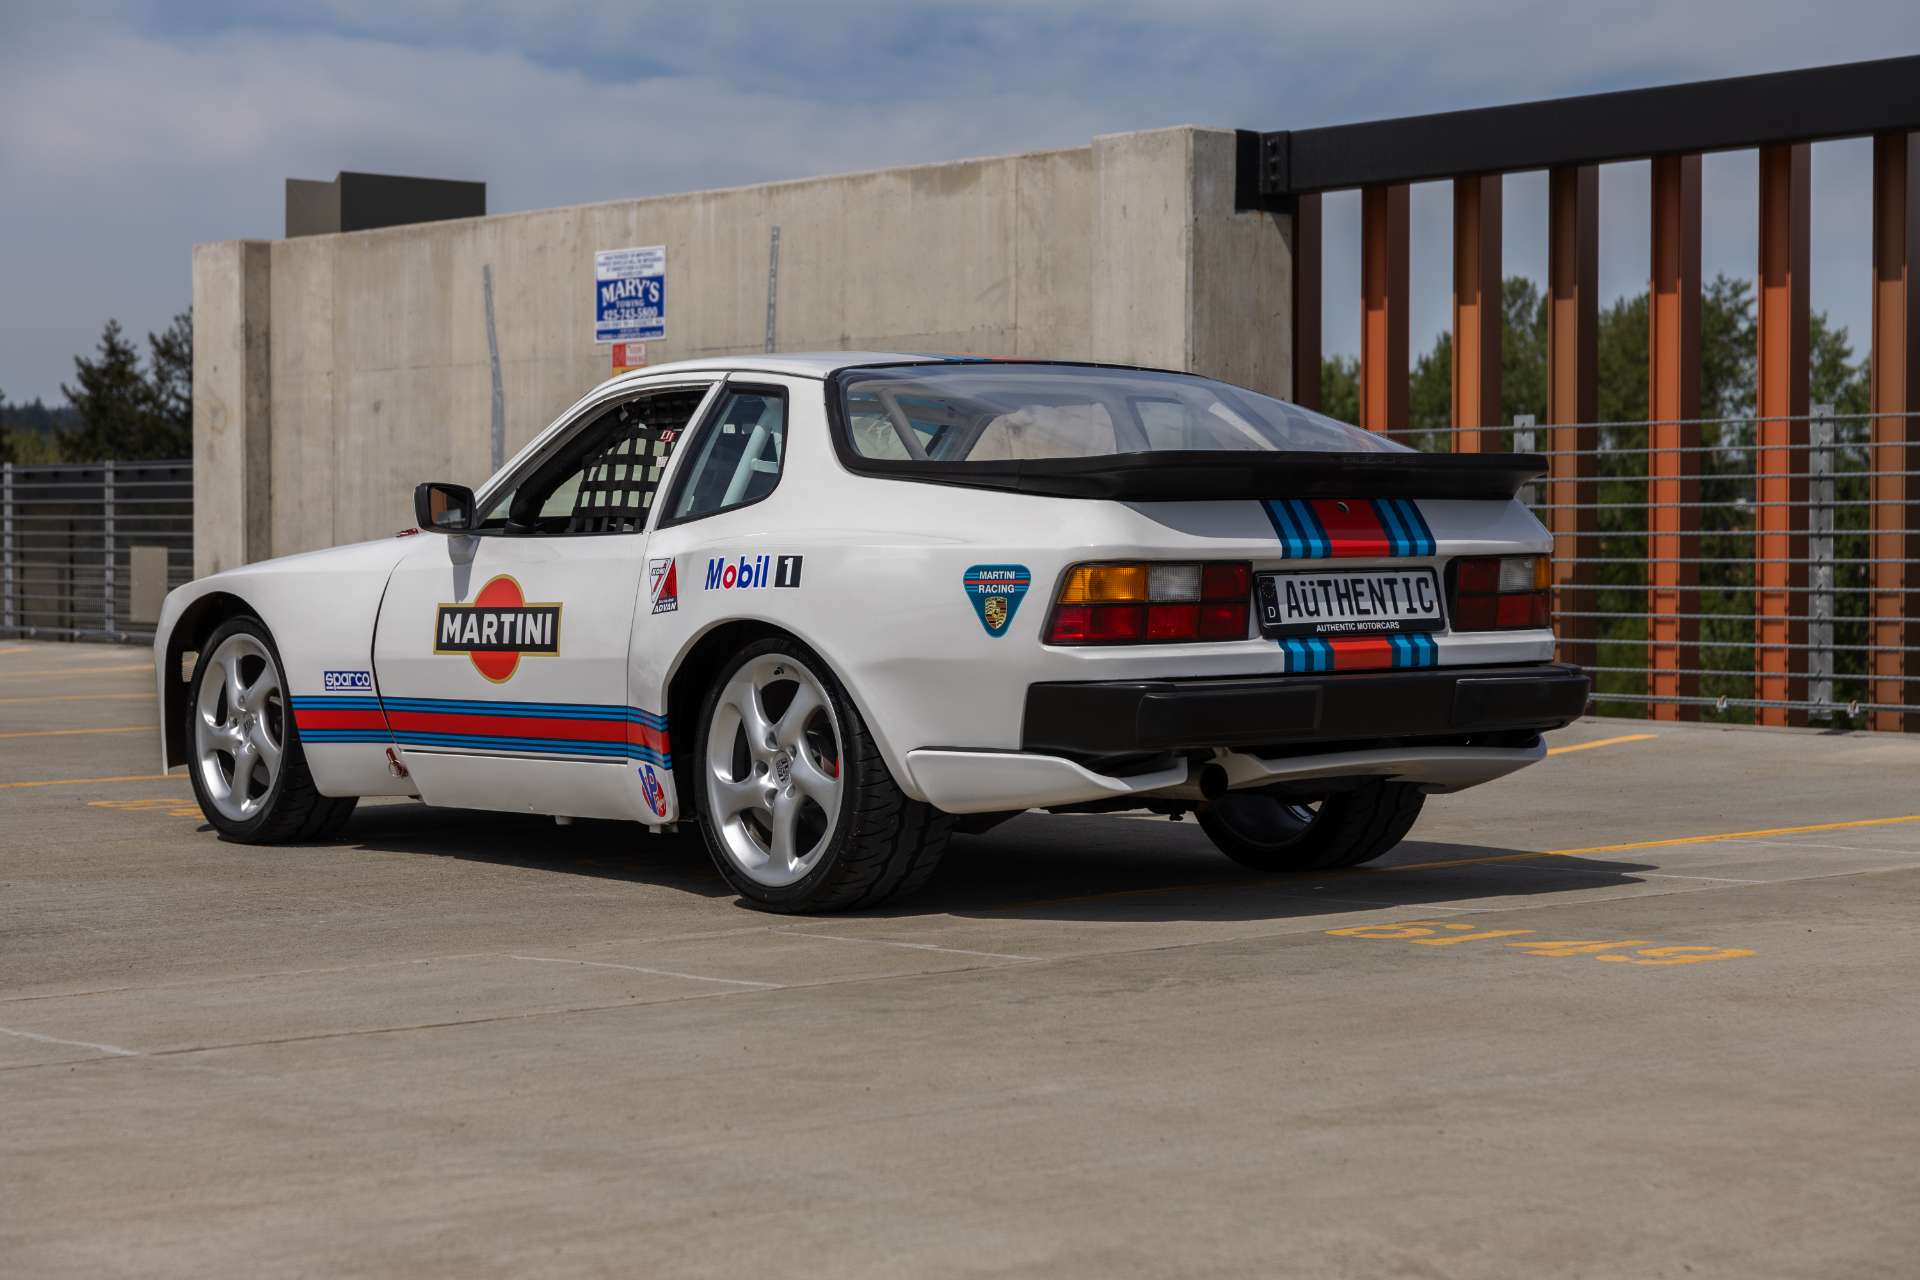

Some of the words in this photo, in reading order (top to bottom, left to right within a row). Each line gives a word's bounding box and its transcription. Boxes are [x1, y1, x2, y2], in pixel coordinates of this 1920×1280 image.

[601, 278, 660, 307] MARY'S
[616, 298, 645, 309] TOWING
[704, 555, 770, 590] Mobil
[979, 570, 1016, 580] MARTINI
[978, 584, 1015, 593] RACING
[654, 602, 677, 613] ADVAN
[1267, 606, 1276, 619] D
[441, 613, 553, 645] MARTINI
[1316, 623, 1356, 633] AUTHENTIC
[1357, 621, 1400, 631] MOTORCARS
[325, 672, 370, 690] sparco
